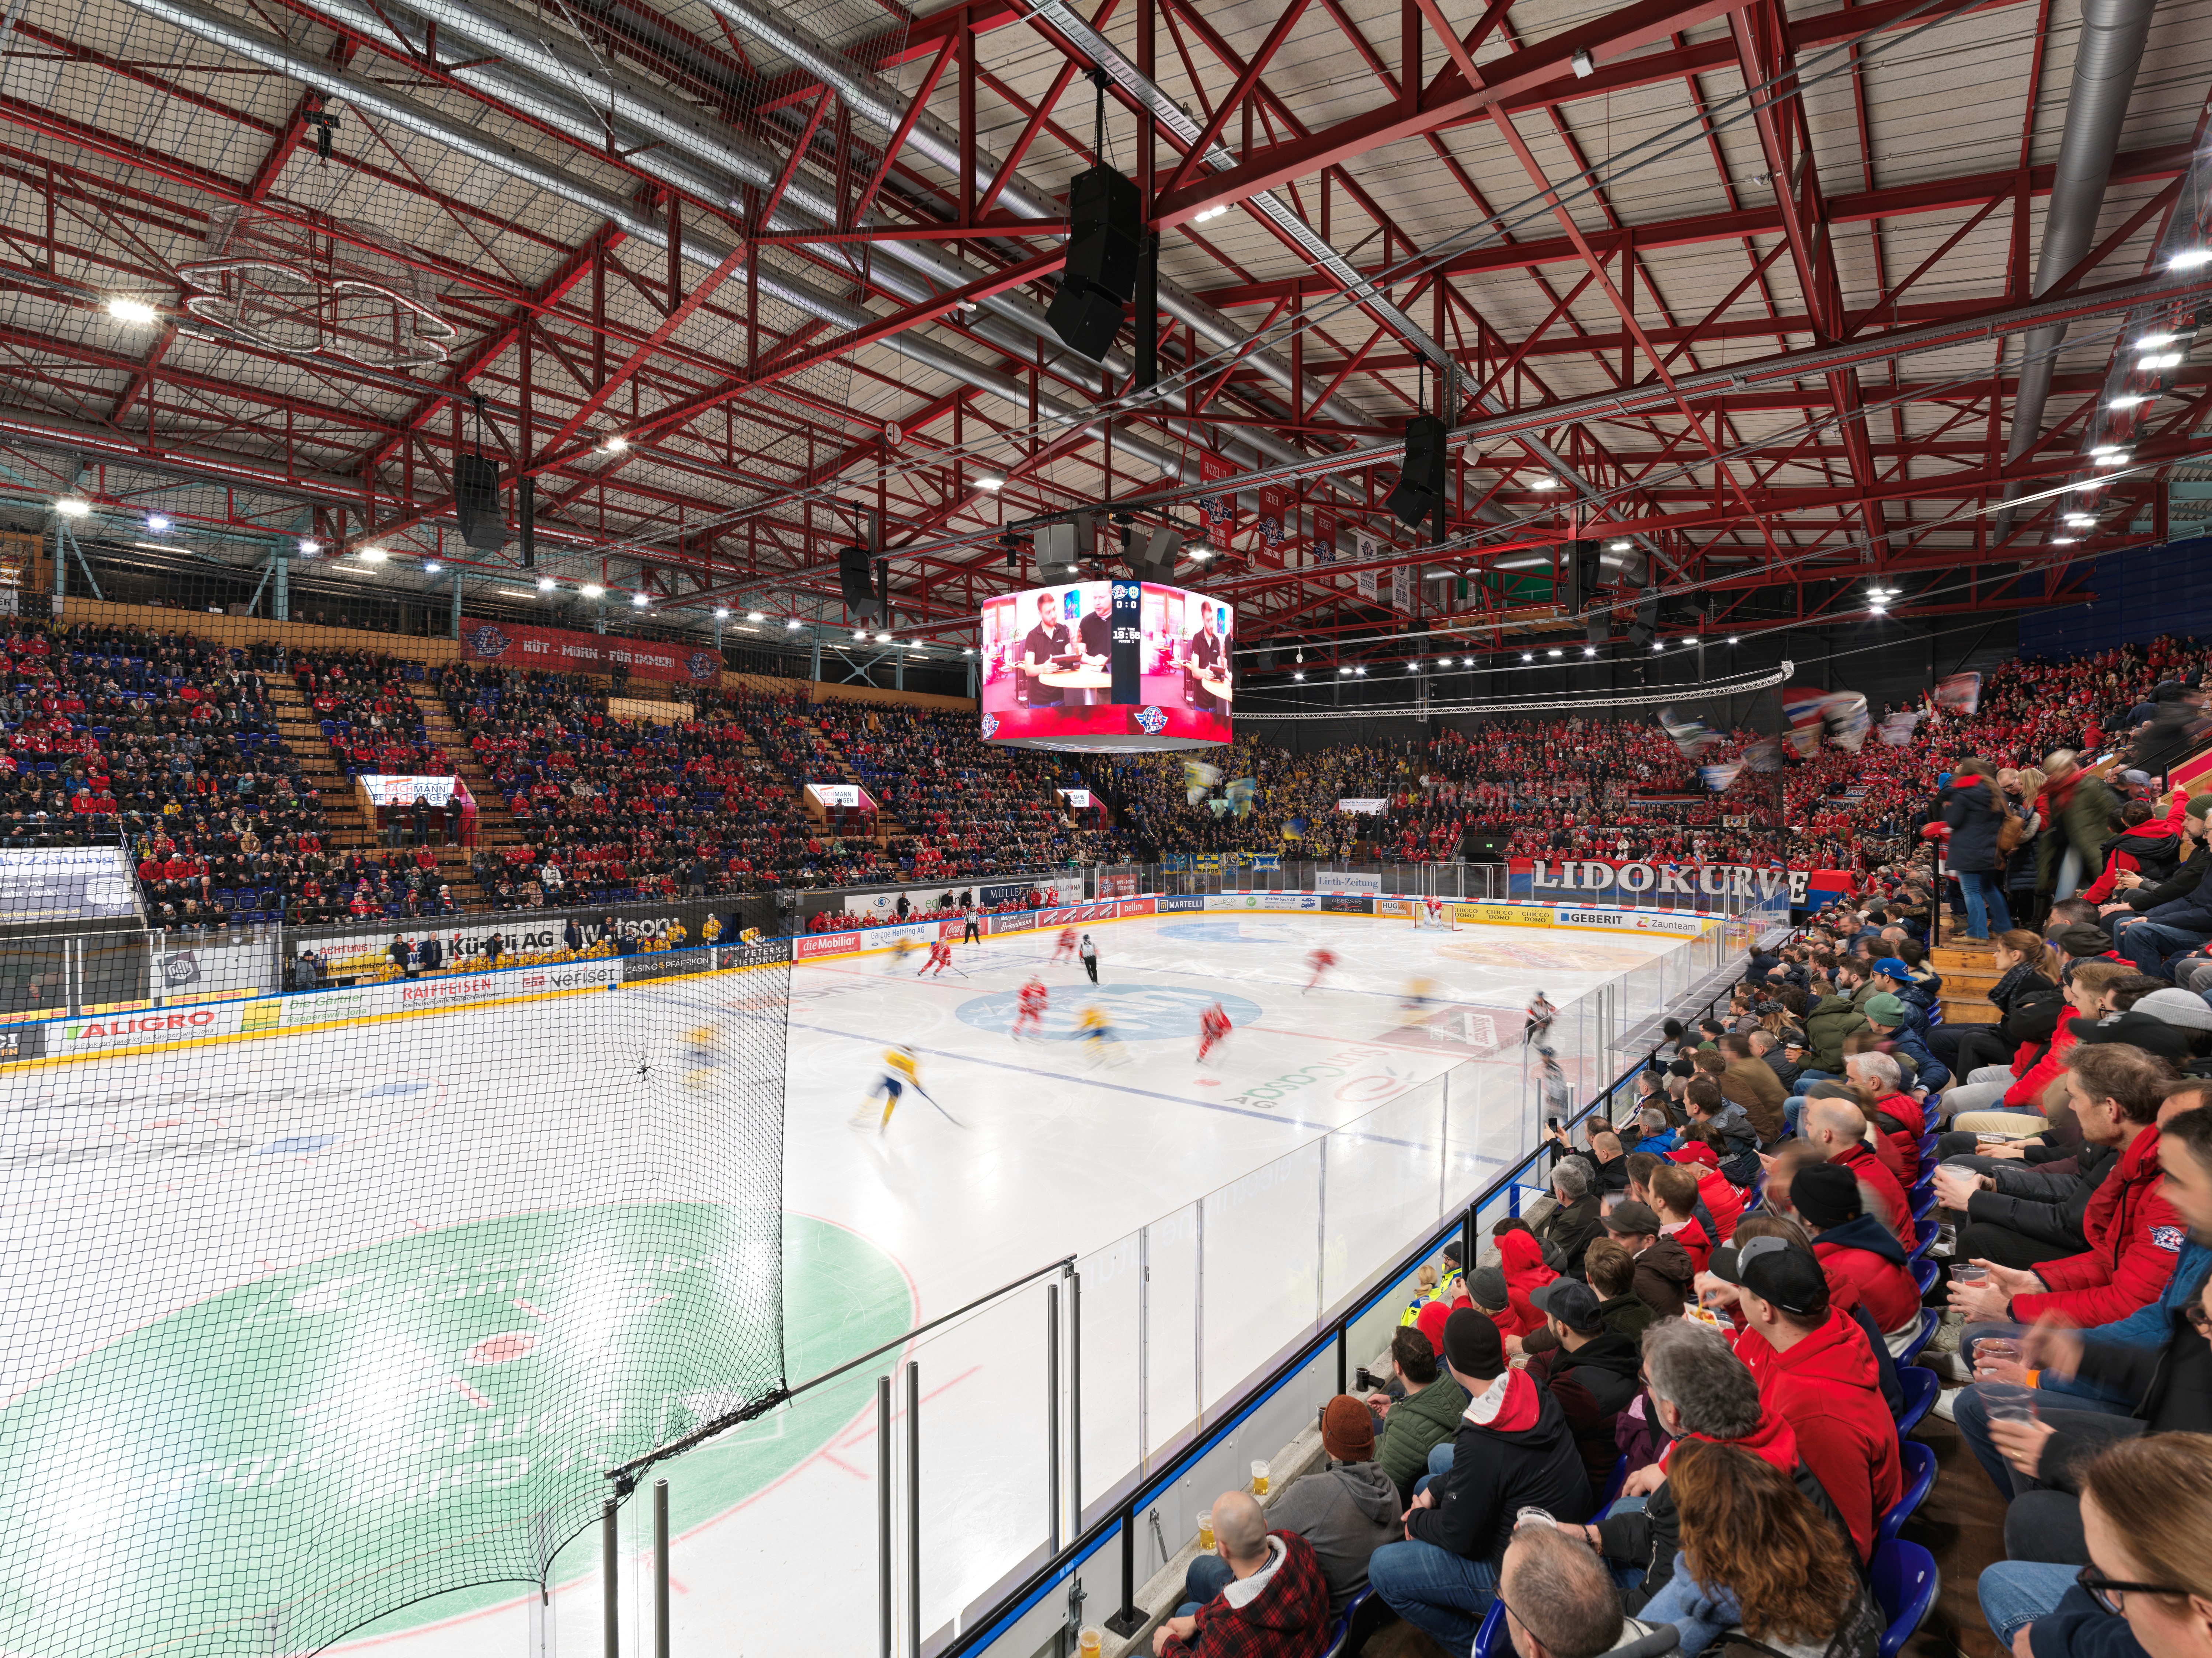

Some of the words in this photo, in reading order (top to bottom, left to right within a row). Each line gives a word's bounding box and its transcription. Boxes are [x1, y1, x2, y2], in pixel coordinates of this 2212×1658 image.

[1266, 492, 1278, 506] GEYER
[1318, 517, 1331, 531] BERGER
[1206, 524, 1225, 538] 2001-2006
[1264, 547, 1280, 560] 2002-2018
[1361, 579, 1375, 590] 2017-2018
[1113, 631, 1140, 639] 19:56
[524, 639, 550, 654] HÜT
[562, 646, 598, 659] MORN
[609, 650, 632, 663] FÜR
[635, 654, 674, 667] IMMER!
[1146, 725, 1162, 733] LAKERS
[386, 785, 445, 793] BACHMANN
[1319, 877, 1378, 889] Linth-Zeitung
[1534, 861, 1809, 903] LIDOKURVE
[1125, 902, 1143, 912] bellini
[1169, 900, 1202, 908] MARTELLI
[1571, 914, 1623, 924] GEBERIT
[1652, 920, 1696, 931] Zaunteam
[581, 918, 670, 942] wtson
[945, 922, 974, 938] Coca-Ca
[1000, 919, 1032, 933] Brönnimann
[871, 931, 890, 940] Garage
[892, 927, 915, 938] Helbling
[320, 943, 372, 955] ACHTUNG!
[449, 933, 517, 960] Küli
[522, 931, 553, 949] AG
[803, 940, 817, 952] die
[818, 936, 855, 949] Mobiliar
[745, 946, 788, 957] PETERKA
[331, 963, 357, 972] Lakers
[361, 962, 385, 970] nutzen
[733, 954, 788, 967] SIEBDRUCK
[626, 963, 658, 973] CASINO
[403, 979, 490, 1001] RAIFFEISEN
[289, 1000, 310, 1009] Die
[315, 994, 365, 1006] Gärtner
[403, 997, 449, 1008] Raiffeisenbank
[451, 992, 499, 1003] Rapperswil-Jona
[287, 1008, 366, 1024] Rapperswil-Jona
[80, 1011, 215, 1039] ALIGRO
[81, 1037, 142, 1049] Einkaufsmarkt
[153, 1028, 214, 1041] Rapperswil-Jona
